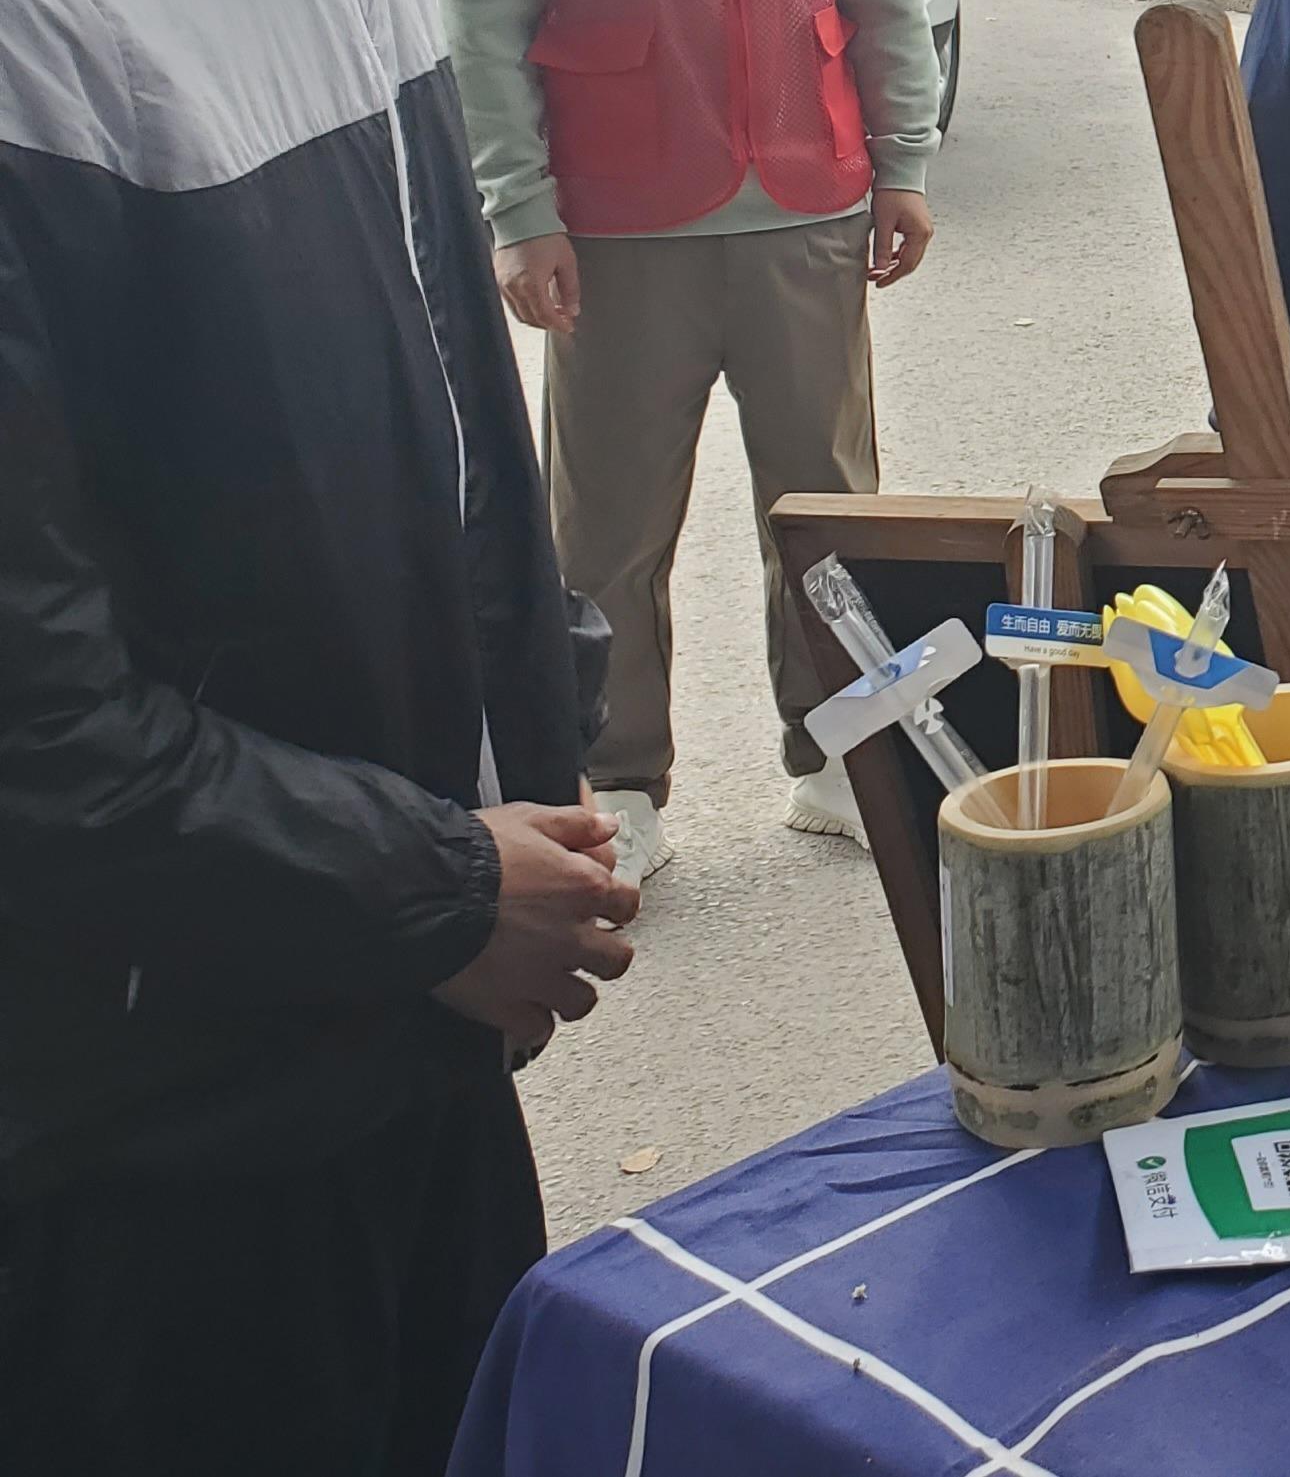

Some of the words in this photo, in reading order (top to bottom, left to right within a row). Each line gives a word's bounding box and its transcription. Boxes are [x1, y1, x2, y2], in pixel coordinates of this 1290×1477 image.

[1001, 614, 1051, 634] 生而自由
[1024, 645, 1041, 654] Have
[1049, 647, 1067, 657] good
[1141, 1170, 1179, 1220] 微信支付
